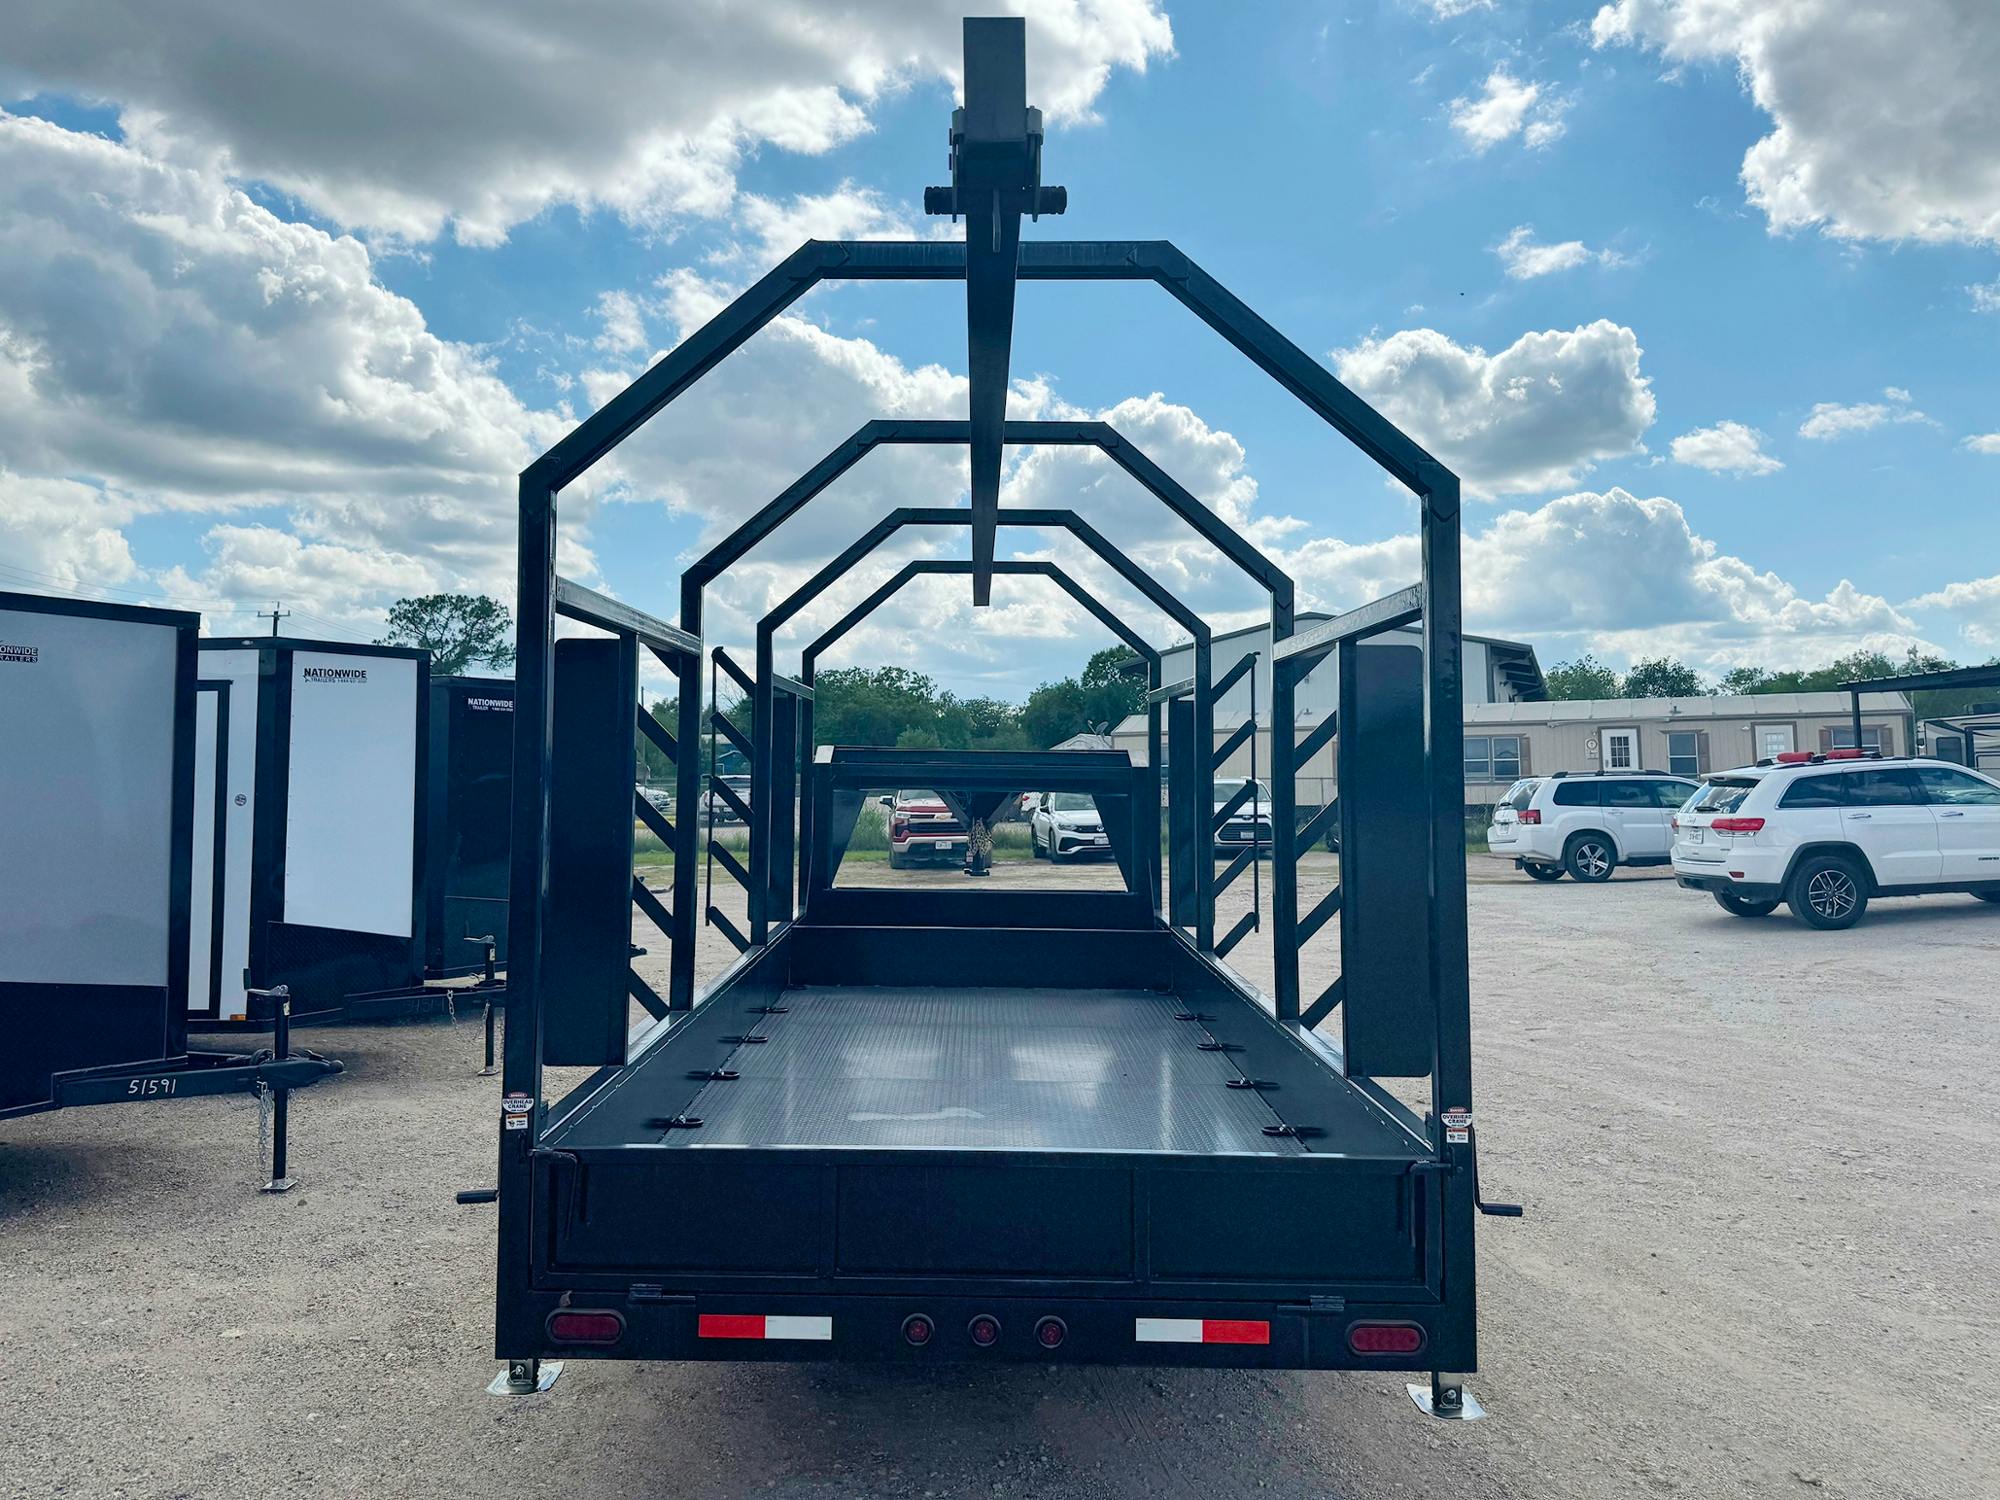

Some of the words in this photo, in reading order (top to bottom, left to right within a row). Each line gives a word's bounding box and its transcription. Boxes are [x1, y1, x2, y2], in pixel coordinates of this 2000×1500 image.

[0, 645, 38, 656] ONWIDE
[304, 667, 367, 679] NATIONWIDE
[468, 698, 514, 708] NATIONWIDE
[128, 1078, 176, 1095] 51591
